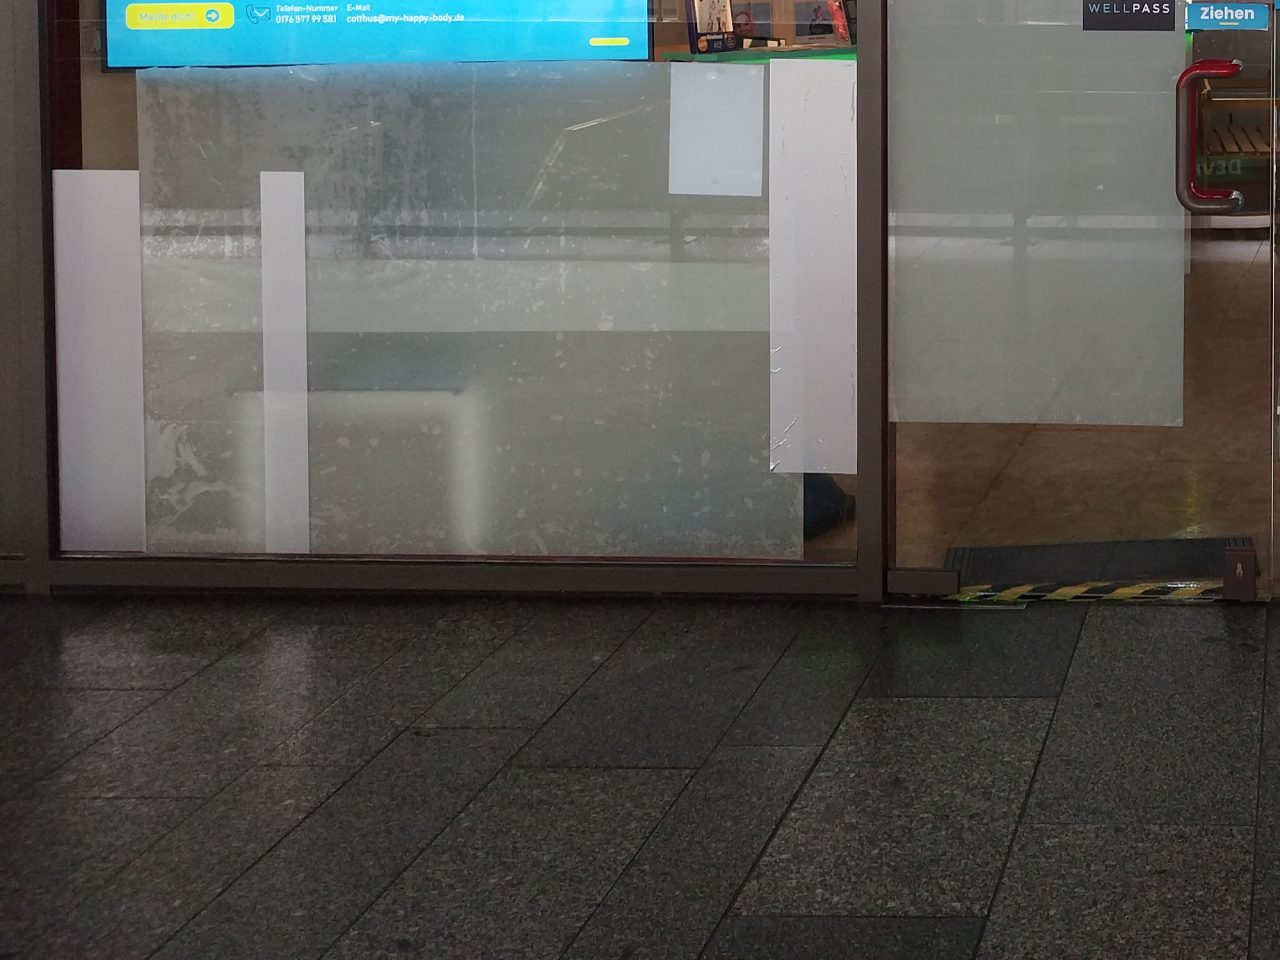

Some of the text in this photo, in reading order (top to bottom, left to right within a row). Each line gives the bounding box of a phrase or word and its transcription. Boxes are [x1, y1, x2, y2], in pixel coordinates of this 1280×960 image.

[1088, 3, 1170, 14] WELLPASS
[1200, 5, 1255, 20] Ziehen
[276, 15, 293, 24] 0176
[311, 15, 321, 24] 99
[346, 13, 465, 24] cottbus@my-happy-body.de
